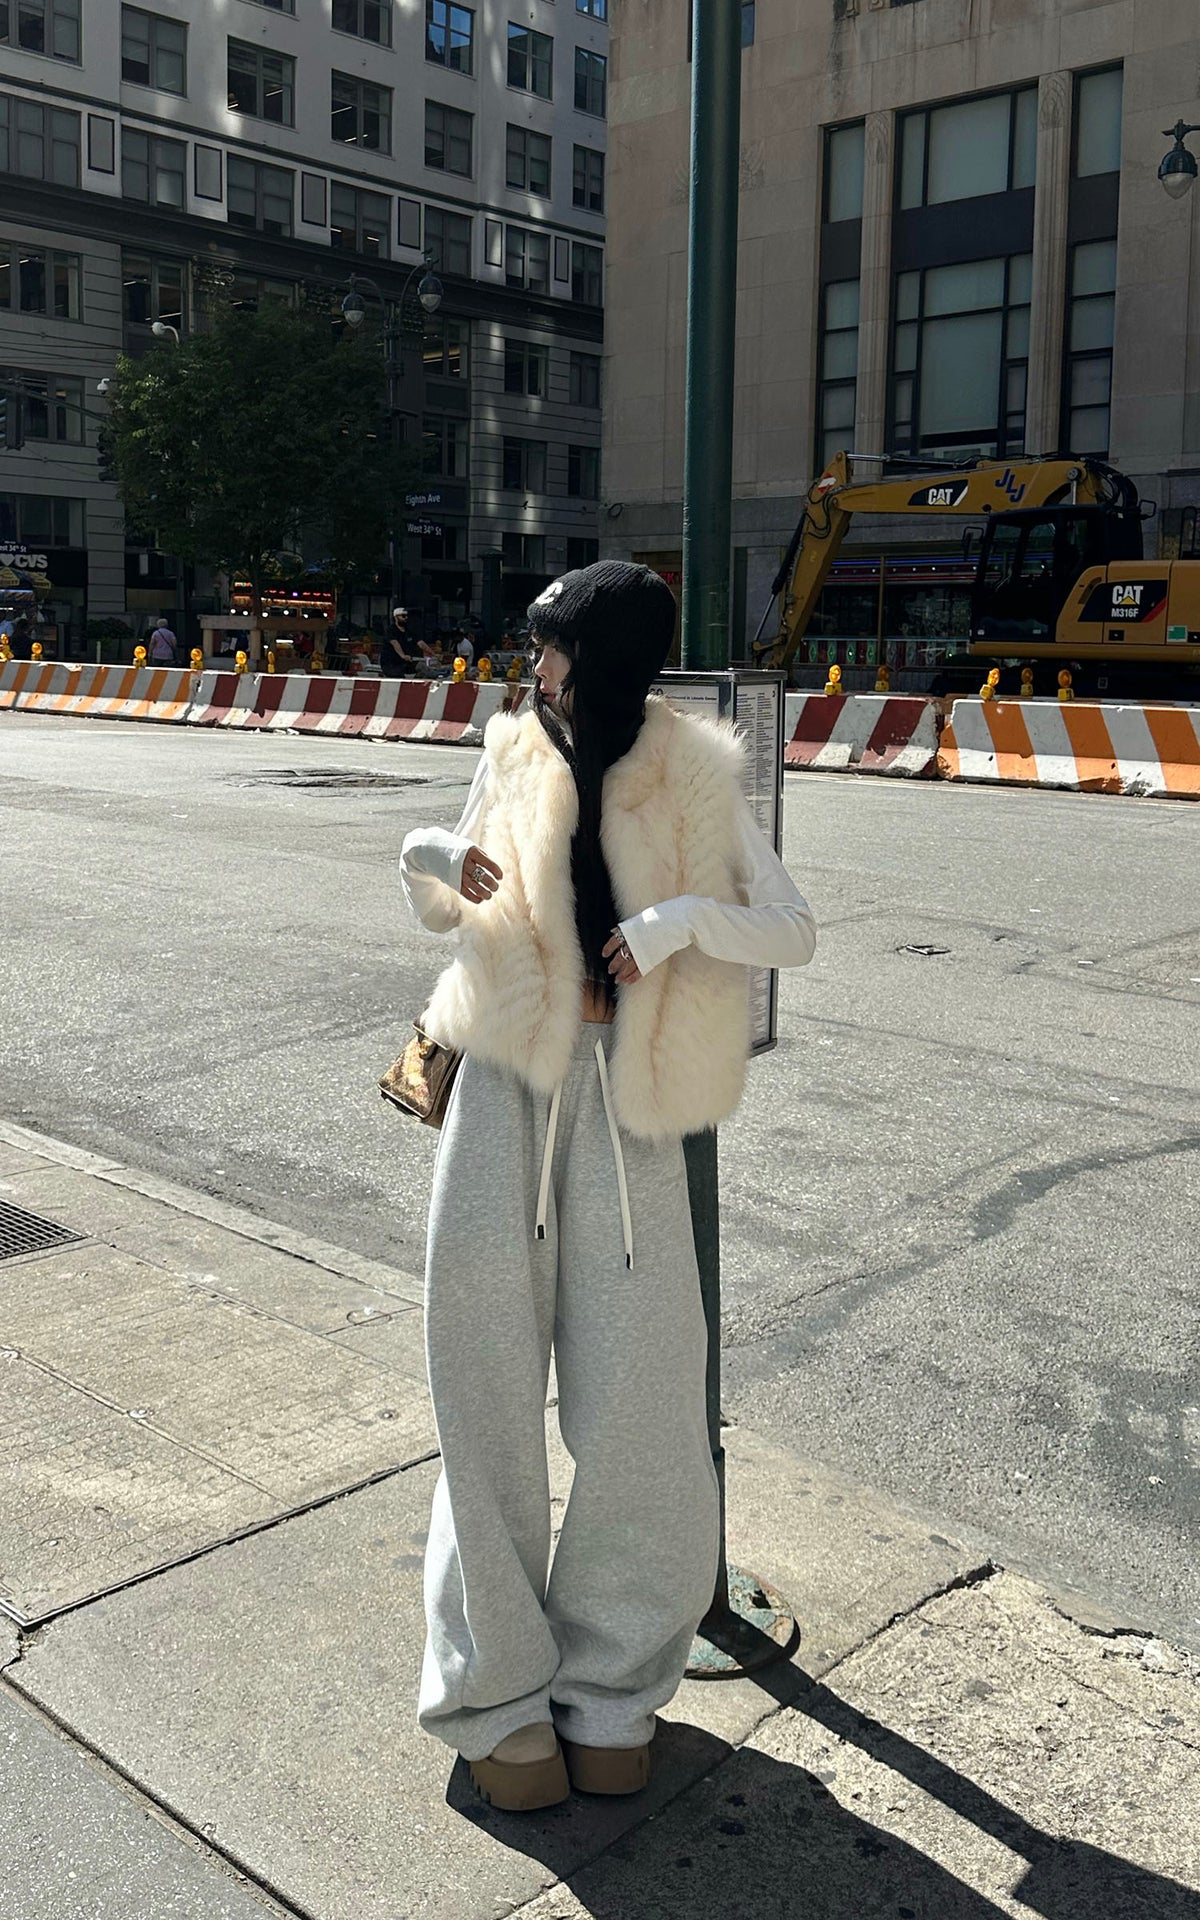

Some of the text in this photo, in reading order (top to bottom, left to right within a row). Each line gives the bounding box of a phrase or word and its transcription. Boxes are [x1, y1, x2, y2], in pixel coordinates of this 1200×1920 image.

[995, 468, 1026, 503] JLJ
[405, 493, 441, 507] Eighth Ave
[928, 488, 953, 505] CAT
[407, 523, 422, 533] West
[435, 526, 442, 536] St
[14, 554, 48, 569] CVS
[1111, 585, 1144, 605] CAT
[1111, 607, 1139, 618] M316F
